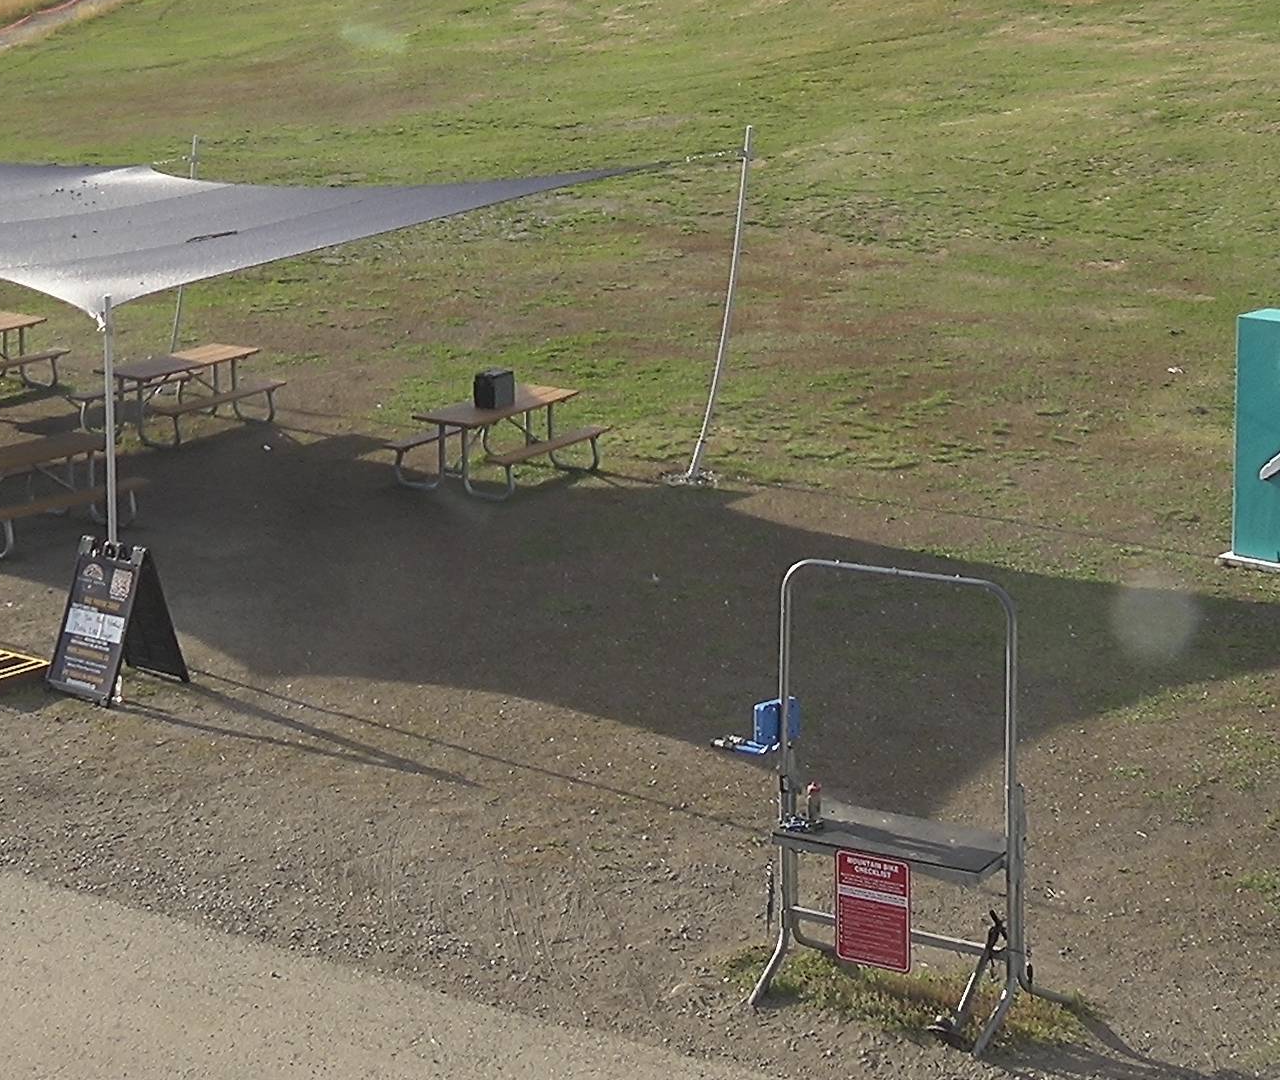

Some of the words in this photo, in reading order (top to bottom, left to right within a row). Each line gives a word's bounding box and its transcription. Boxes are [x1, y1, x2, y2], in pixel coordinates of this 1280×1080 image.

[846, 856, 882, 870] MOUNTAIN
[883, 863, 899, 873] BIKE
[854, 865, 891, 879] CHECKLIST
